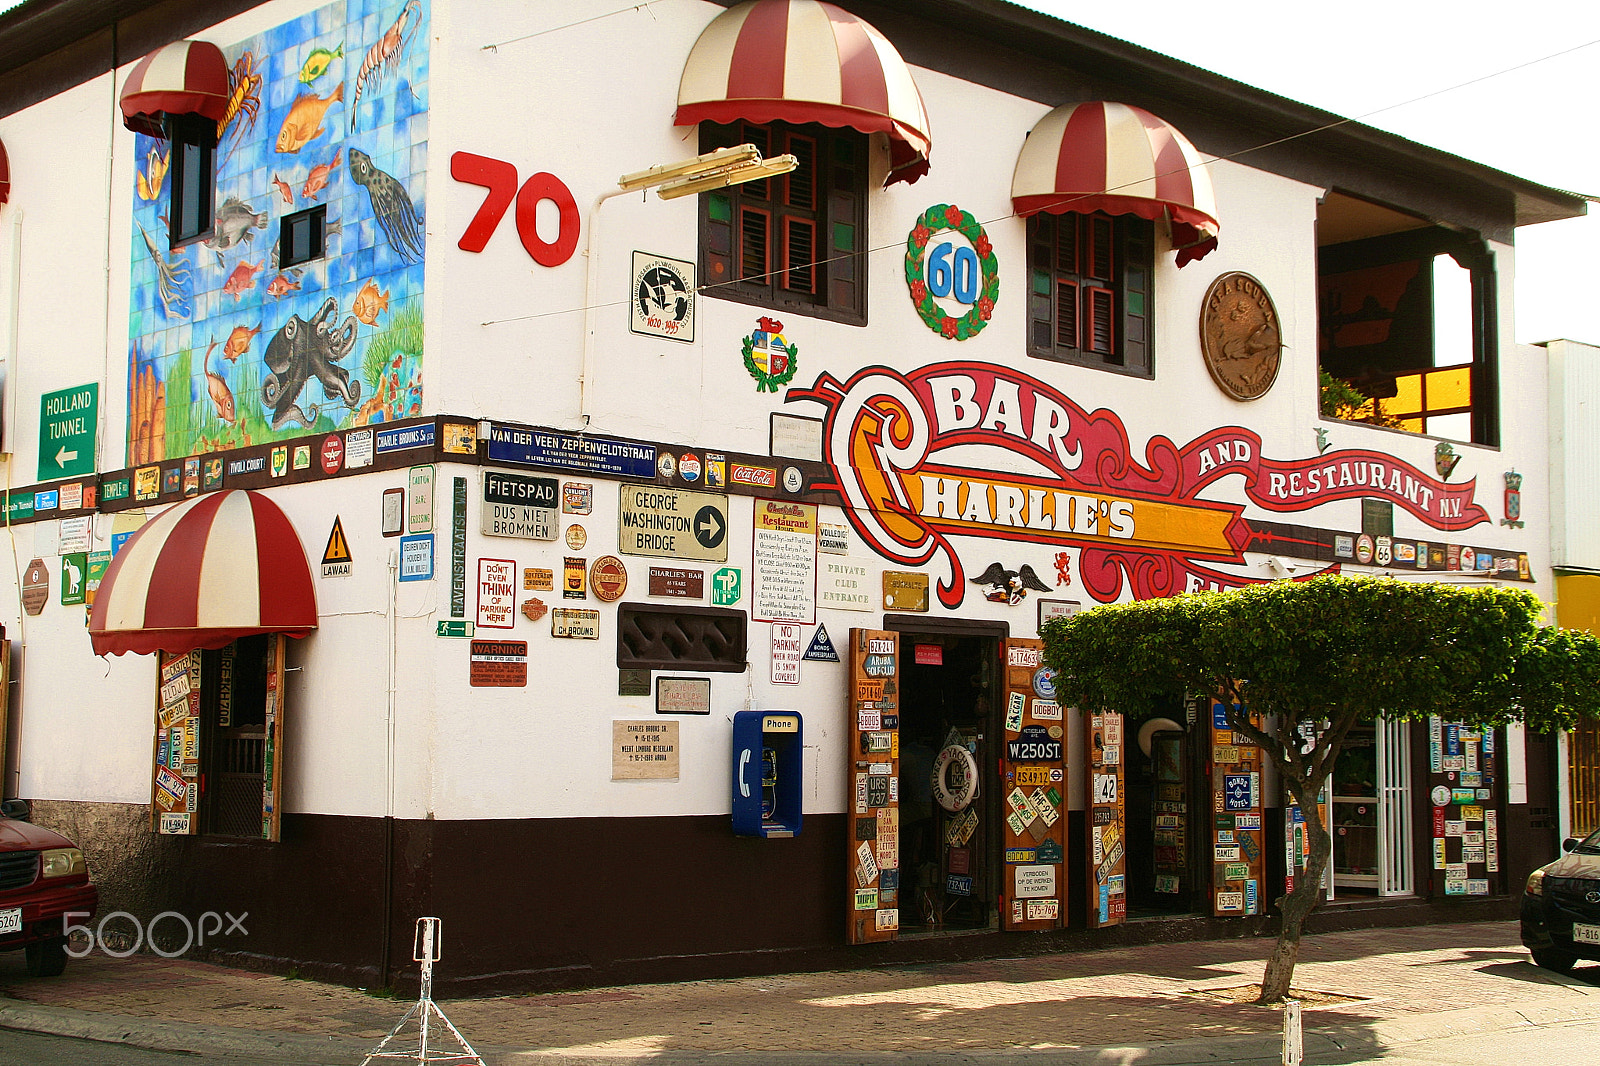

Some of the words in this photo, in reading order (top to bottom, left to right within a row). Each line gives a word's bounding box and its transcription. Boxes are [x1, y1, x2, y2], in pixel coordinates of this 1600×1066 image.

[450, 151, 581, 268] 70
[927, 242, 978, 305] 60
[46, 390, 91, 416] HOLLAND
[49, 417, 88, 440] TUNNEL
[926, 374, 1084, 471] BAR
[348, 431, 371, 443] REWARD
[377, 432, 398, 448] CHARLIE
[491, 429, 511, 443] VAN
[513, 432, 532, 446] DER
[535, 435, 559, 450] VEEN
[561, 438, 654, 461] ZEPPENVELDTSTRAAT
[273, 453, 285, 468] BP
[1198, 440, 1252, 476] AND
[229, 461, 247, 475] TIVOLI
[247, 457, 264, 473] COURT
[104, 482, 121, 498] TEMPLE
[488, 479, 554, 500] FIETSPAD
[1269, 461, 1434, 513] RESTAURANT
[635, 491, 678, 511] GEORGE
[410, 514, 430, 525] CROSSING
[494, 506, 516, 520] DUS
[523, 509, 549, 523] NIET
[622, 511, 691, 532] WASHINGTON
[762, 514, 809, 529] Restaurant
[493, 521, 549, 538] BROMMEN
[636, 533, 676, 551] BRIDGE
[1378, 547, 1390, 560] 66
[323, 565, 351, 576] LAWAAI
[452, 512, 467, 616] HAVENSTRAATSE
[486, 565, 509, 574] DON'T
[828, 564, 866, 576] PRIVATE
[650, 569, 686, 578] CHARLIE'S
[688, 571, 703, 580] BAR
[481, 582, 513, 596] THINK
[835, 579, 858, 589] CLUB
[491, 597, 502, 605] OF
[823, 591, 869, 604] ENTRANCE
[480, 605, 512, 614] PARKING
[486, 613, 506, 622] HERE
[780, 626, 792, 638] NO
[473, 645, 525, 655] WARNING
[773, 638, 800, 652] PARKING
[773, 653, 786, 661] WHEN
[787, 653, 799, 662] ROAD
[871, 655, 892, 667] ARUBA
[191, 652, 200, 682] 1472
[775, 663, 781, 671] IS
[782, 663, 796, 671] SNOW
[774, 672, 797, 682] COVERED
[766, 718, 792, 728] Phone
[172, 730, 181, 747] 193
[949, 747, 970, 772] YACHT
[870, 778, 886, 790] URS
[1102, 777, 1115, 799] 42
[1228, 777, 1248, 788] BONDS
[870, 792, 886, 805] 737
[1229, 798, 1249, 808] HOTEL
[883, 817, 892, 825] SAN
[878, 825, 897, 833] NICOLAS
[883, 834, 896, 842] FOUR
[879, 841, 896, 850] LETTER
[1226, 866, 1248, 876] DANGER
